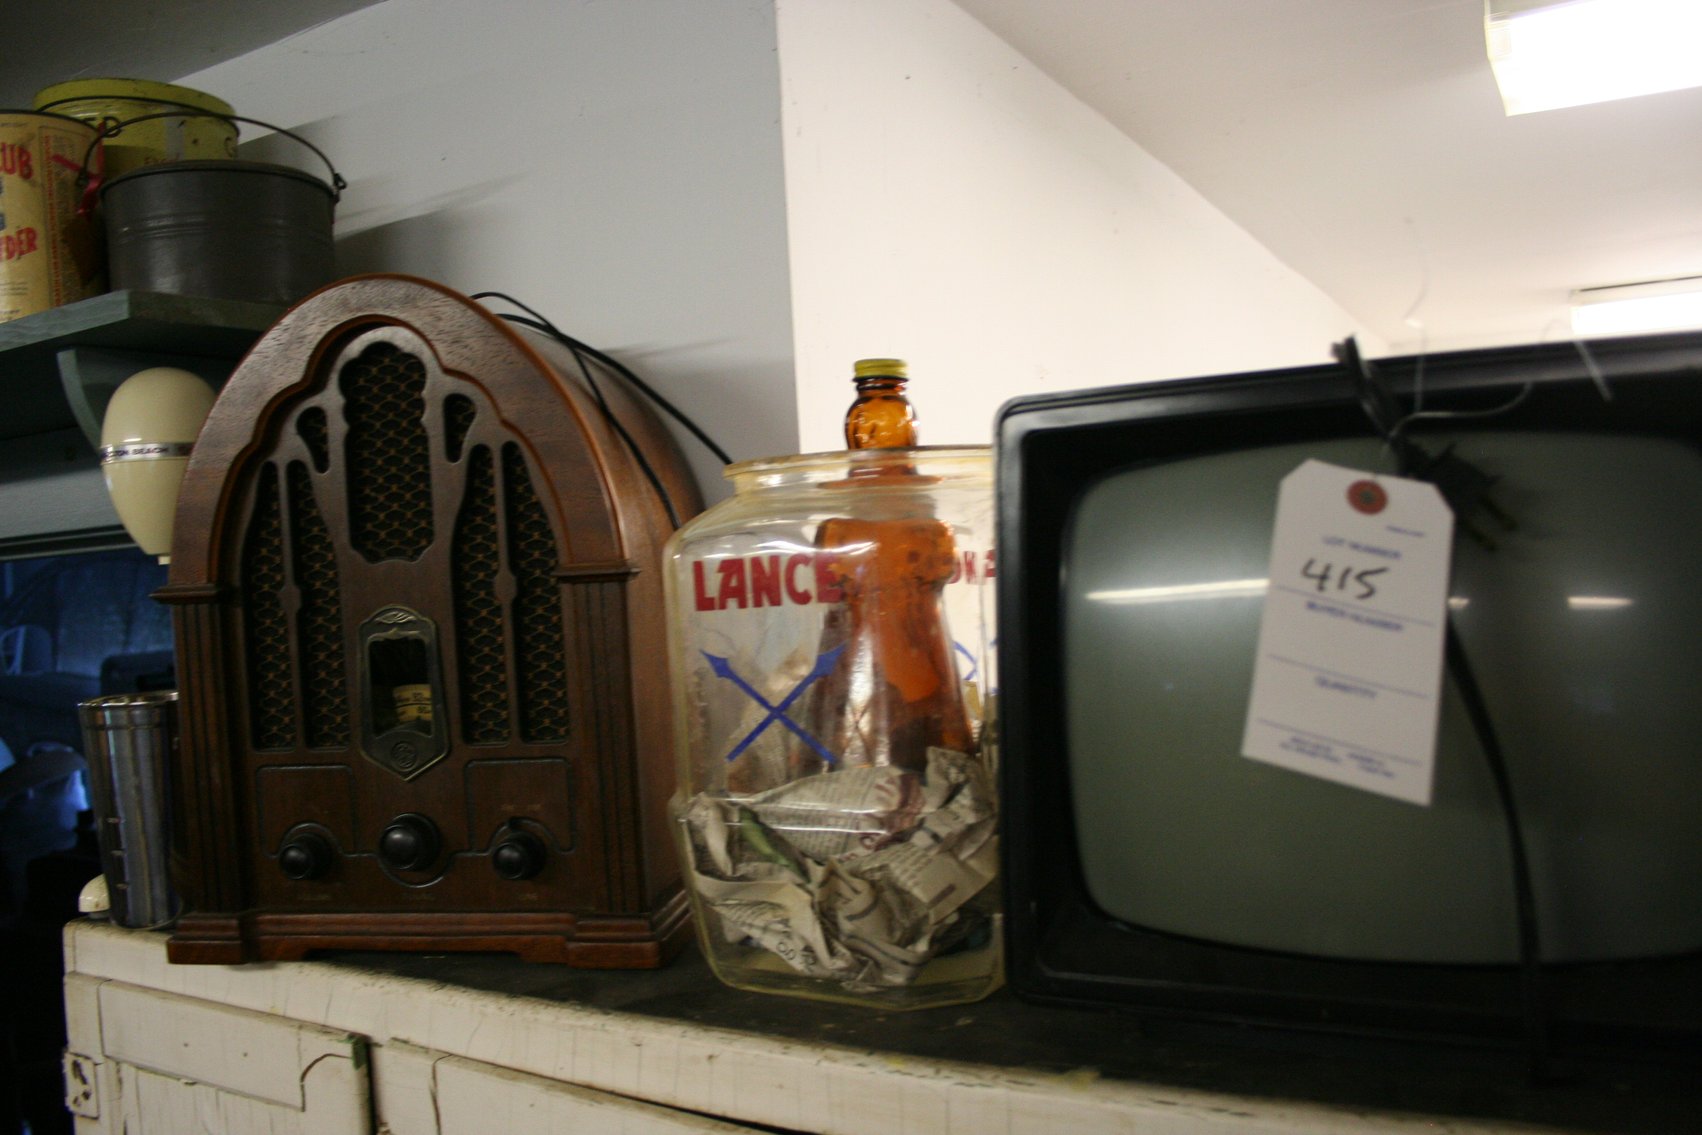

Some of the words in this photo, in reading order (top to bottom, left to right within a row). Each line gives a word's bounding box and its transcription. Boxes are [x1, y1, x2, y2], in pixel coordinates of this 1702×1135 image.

[0, 142, 33, 180] UB
[0, 227, 38, 260] DER
[693, 551, 843, 612] LANCE
[1302, 557, 1389, 600] 415
